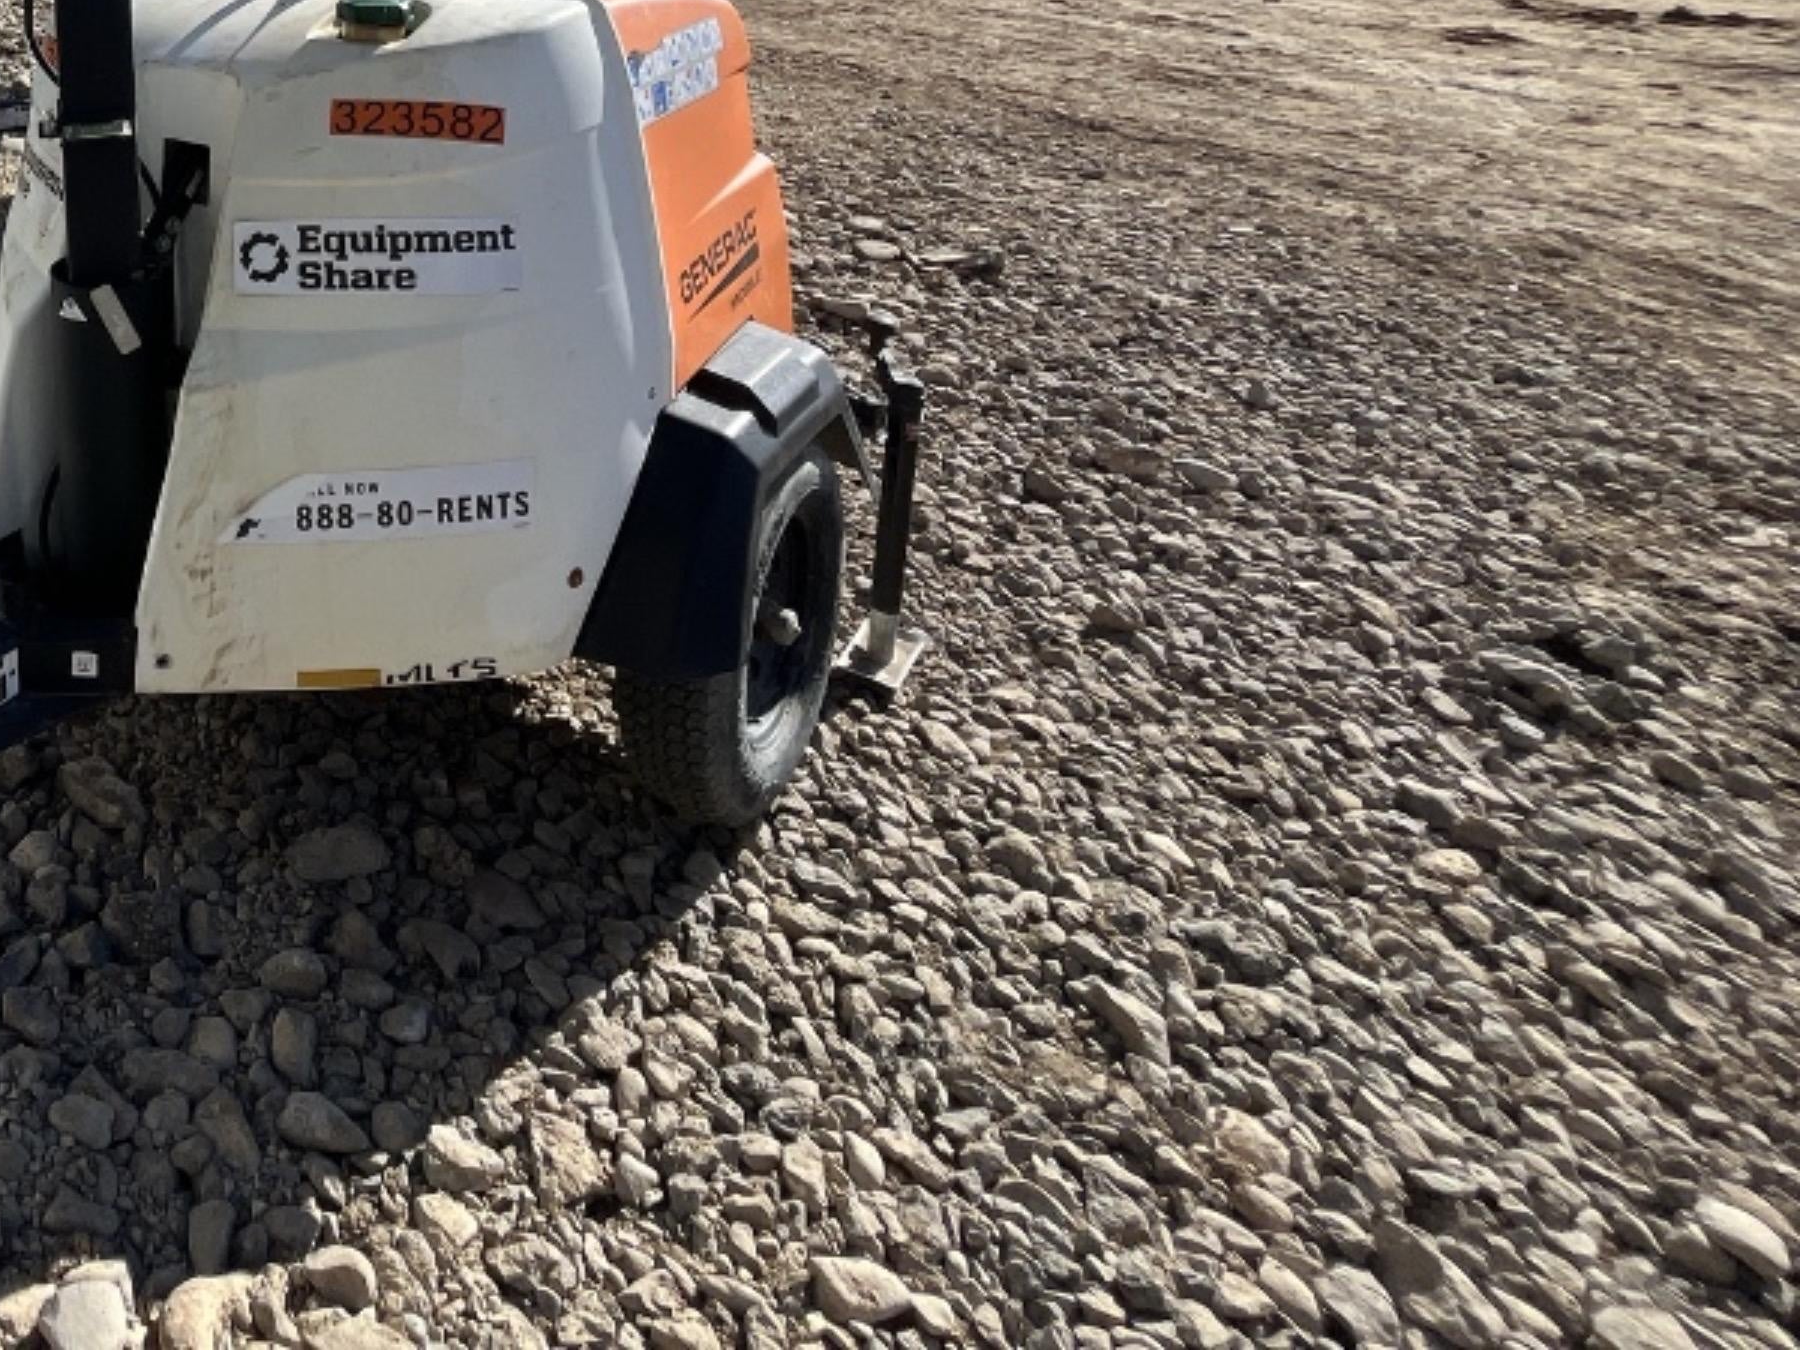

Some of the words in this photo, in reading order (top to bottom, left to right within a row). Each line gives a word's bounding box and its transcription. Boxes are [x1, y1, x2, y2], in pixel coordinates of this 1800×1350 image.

[334, 101, 504, 142] 323582
[296, 224, 516, 261] Equipment
[680, 207, 757, 304] GENERAC
[297, 261, 417, 291] Share
[344, 482, 379, 496] NOW
[296, 491, 530, 531] 888-80-RENTS
